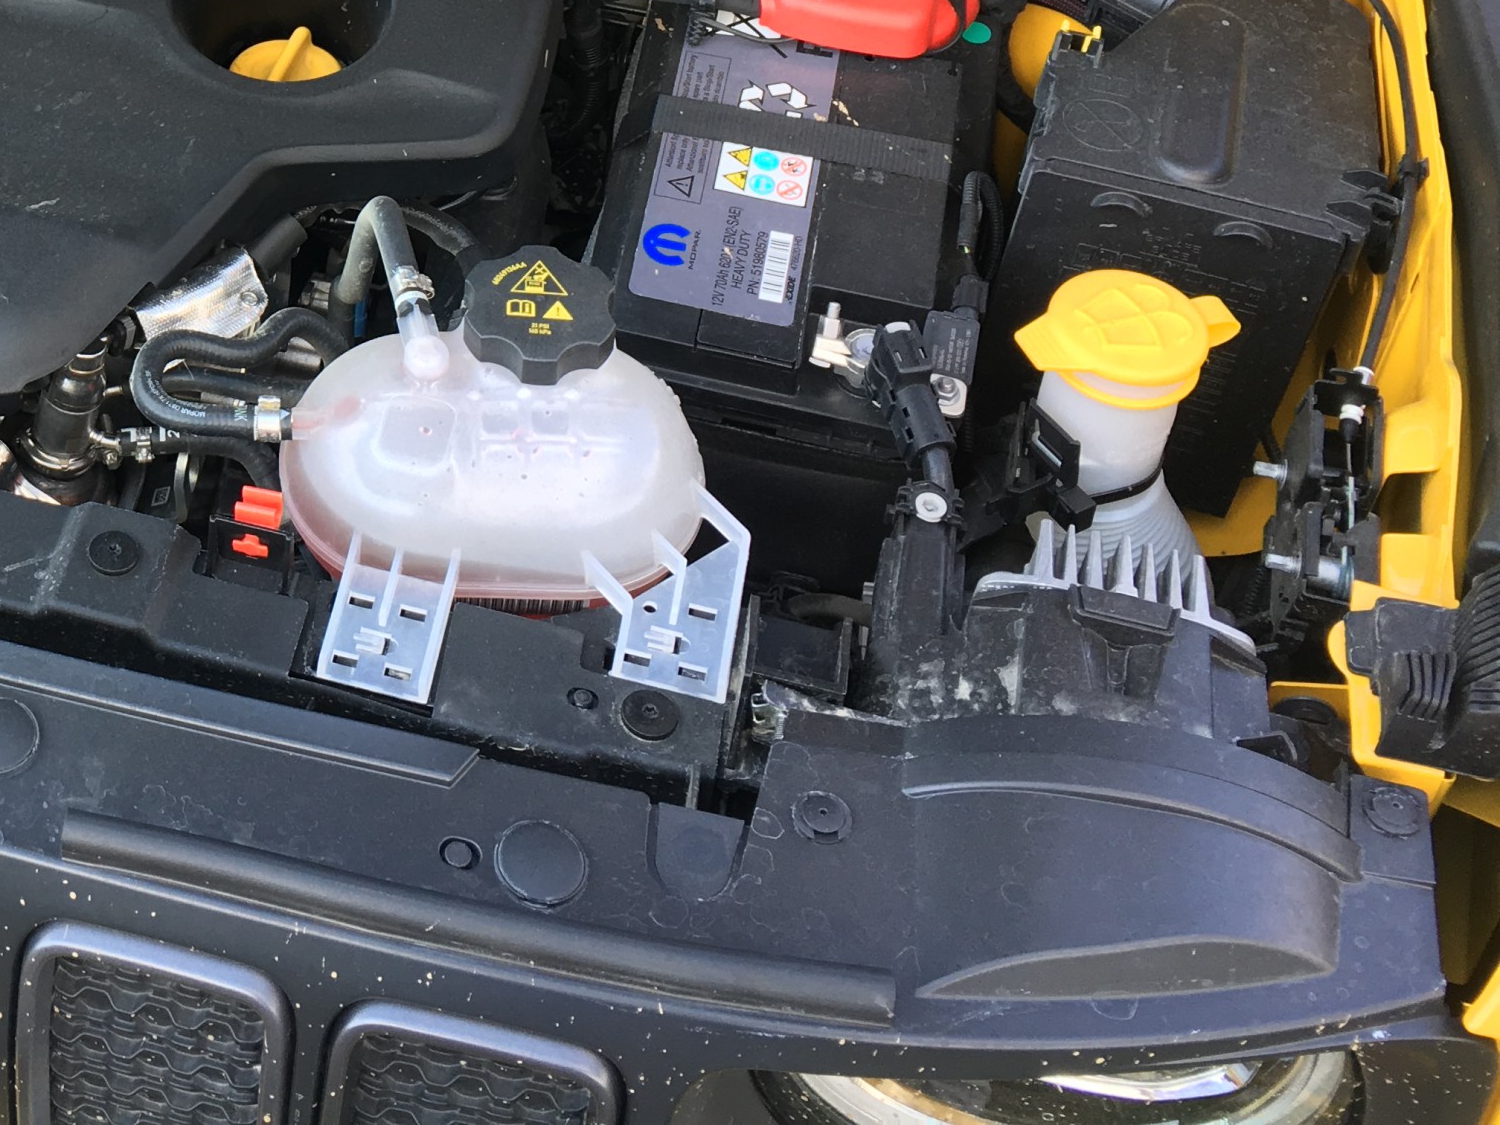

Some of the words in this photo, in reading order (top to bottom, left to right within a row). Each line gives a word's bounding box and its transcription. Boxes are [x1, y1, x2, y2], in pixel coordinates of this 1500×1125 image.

[688, 230, 701, 270] MOPAR
[731, 257, 744, 289] HEAVY
[740, 231, 753, 257] DUTY
[715, 269, 728, 289] 70Ah
[712, 291, 724, 307] 12V
